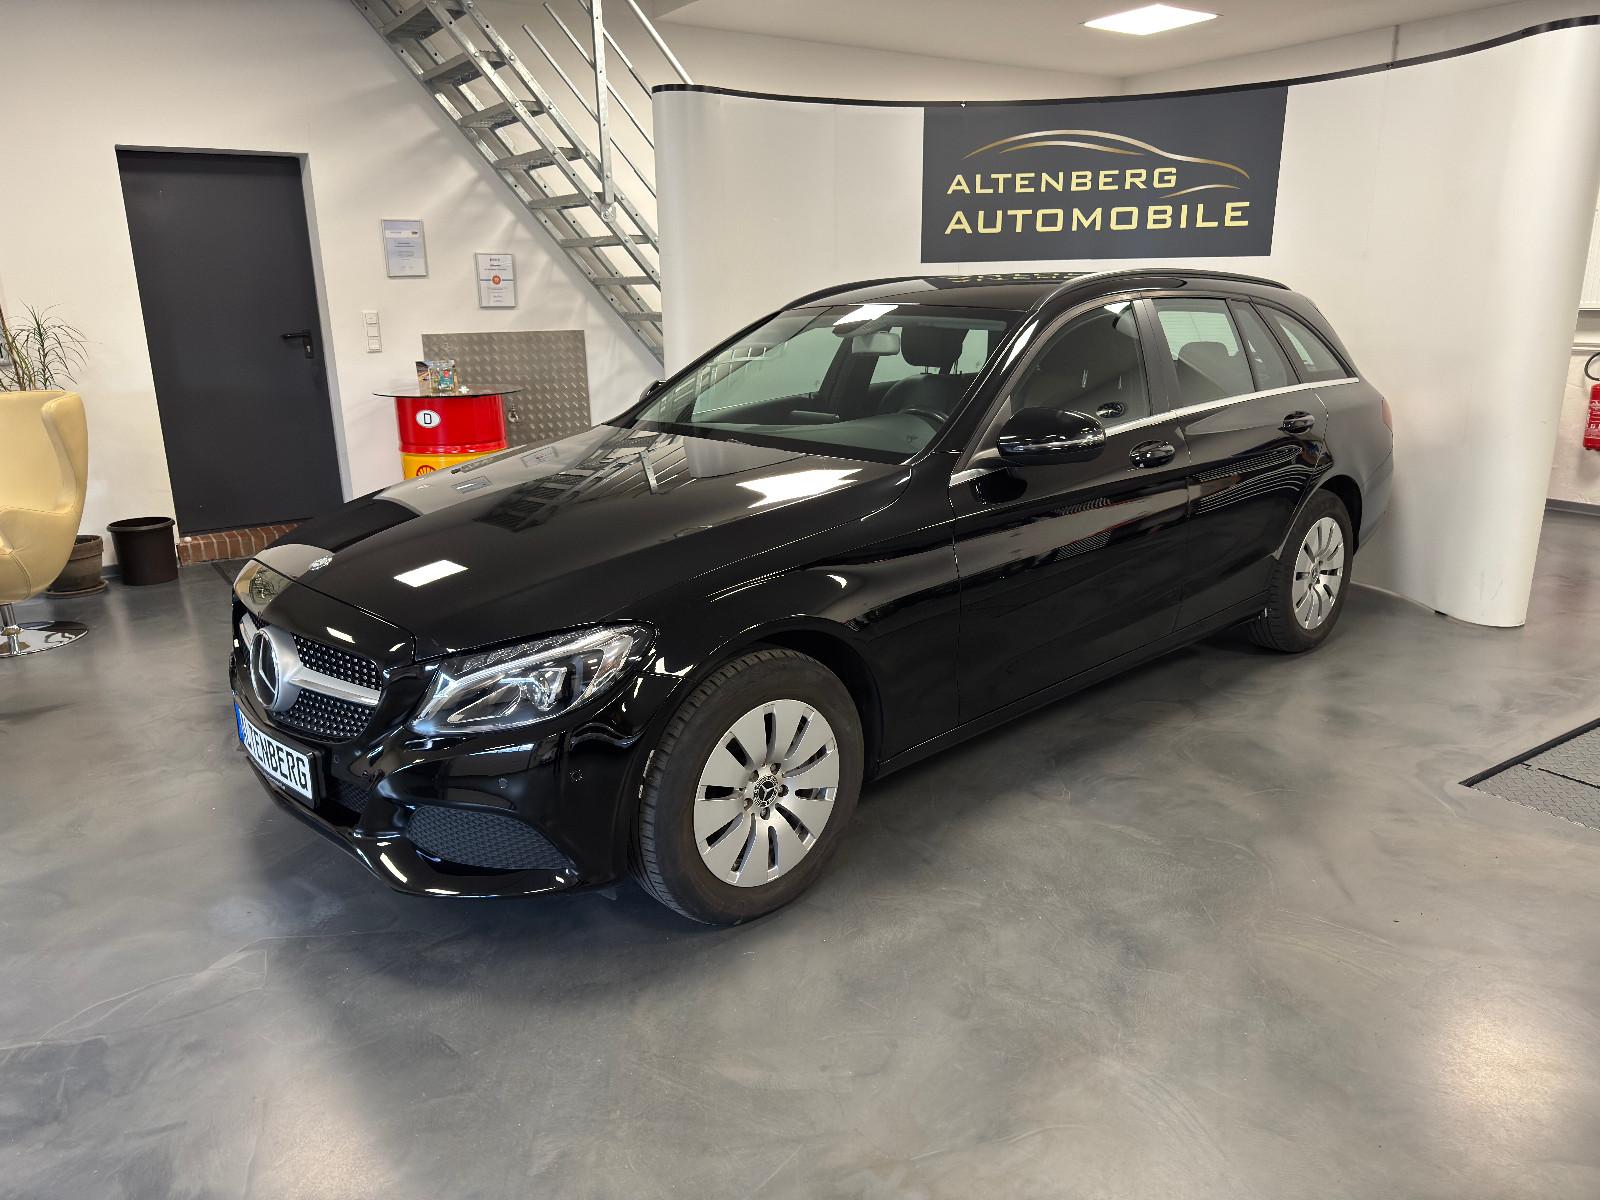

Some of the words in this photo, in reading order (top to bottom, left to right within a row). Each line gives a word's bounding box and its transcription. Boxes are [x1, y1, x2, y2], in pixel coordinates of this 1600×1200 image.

[946, 168, 1177, 194] ALTENBERG
[945, 202, 1250, 234] AUTOMOBILE
[423, 412, 432, 424] D
